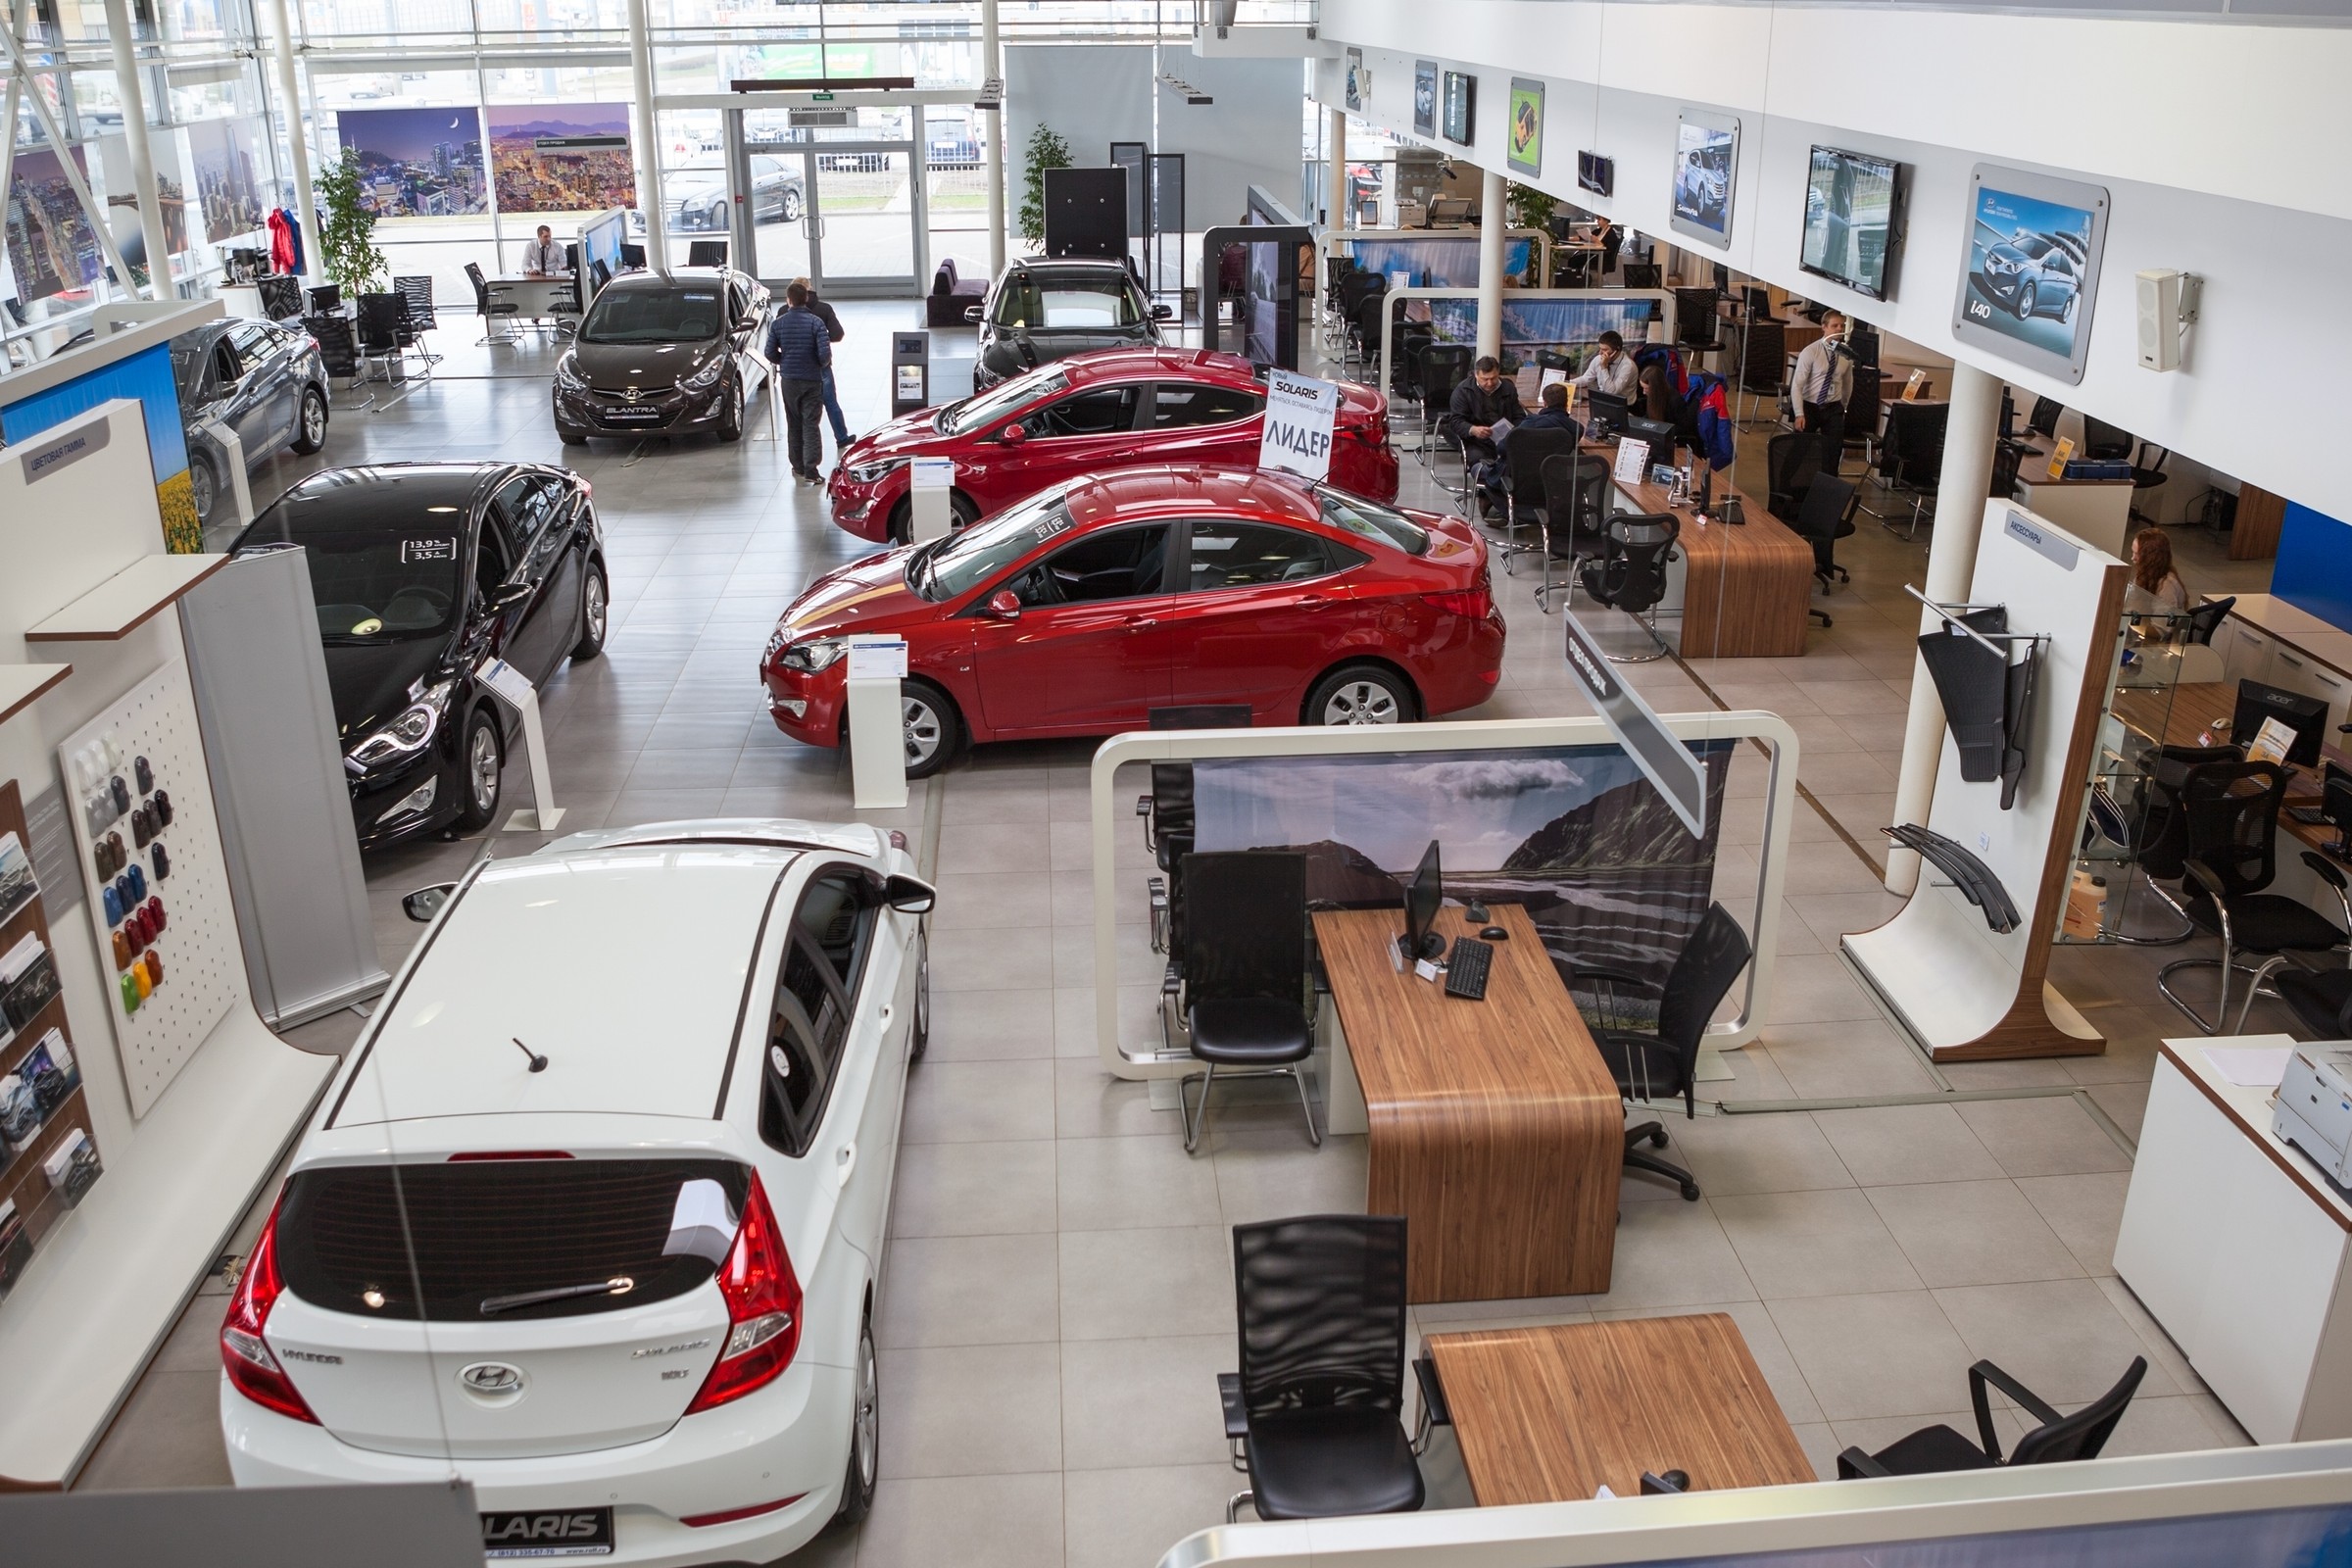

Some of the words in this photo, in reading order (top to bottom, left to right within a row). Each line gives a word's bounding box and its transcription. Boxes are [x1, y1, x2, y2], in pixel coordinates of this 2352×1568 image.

[1970, 299, 1991, 318] i40
[1274, 380, 1318, 400] SOLARIS
[1265, 419, 1330, 458] ЛИДЕР
[30, 447, 65, 471] ЦВЕТОВАЯ
[64, 437, 86, 455] ГАММА
[2010, 520, 2042, 545] АКСЕССУАРЫ
[2267, 692, 2293, 705] acer
[630, 1339, 710, 1359] SOLARIS
[482, 1514, 598, 1539] LARIS
